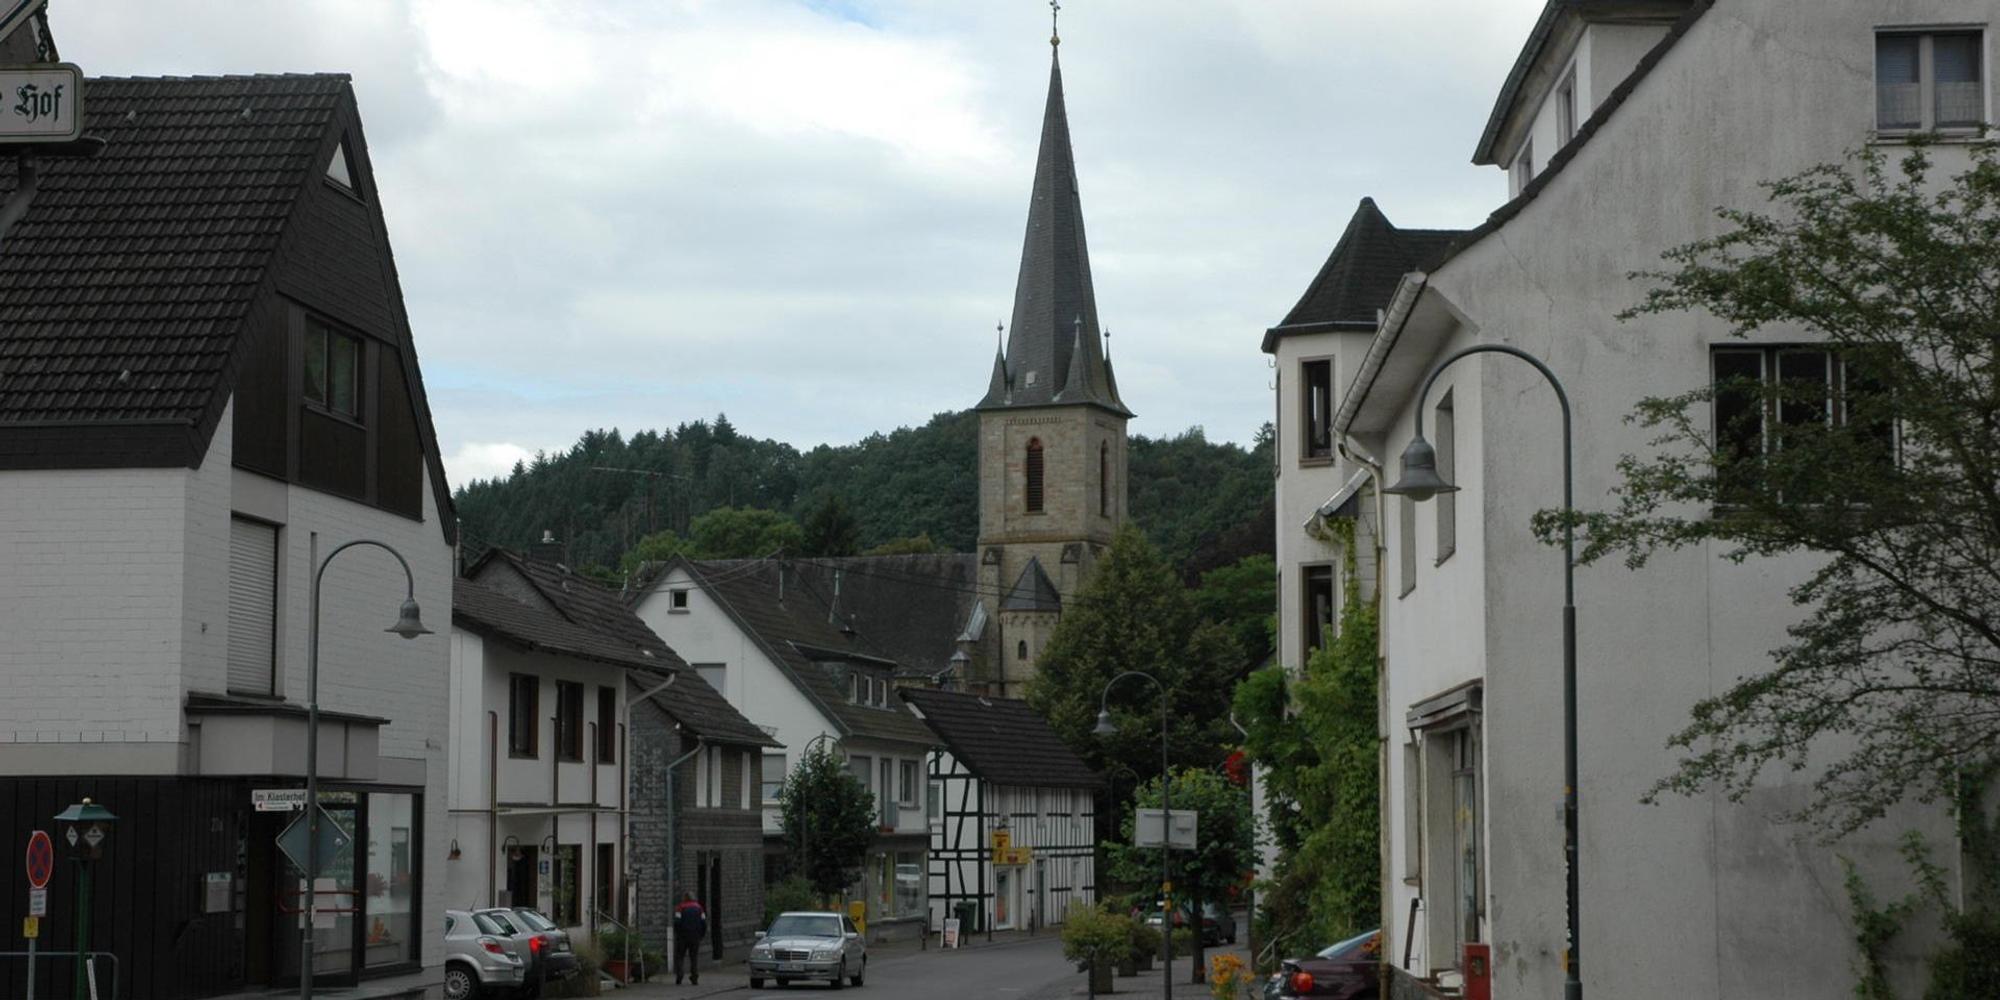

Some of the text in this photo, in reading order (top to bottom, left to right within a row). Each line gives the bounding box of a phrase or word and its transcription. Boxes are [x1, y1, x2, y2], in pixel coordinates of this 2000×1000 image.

[14, 84, 64, 123] Hof
[255, 791, 306, 801] Im Klosterhof
